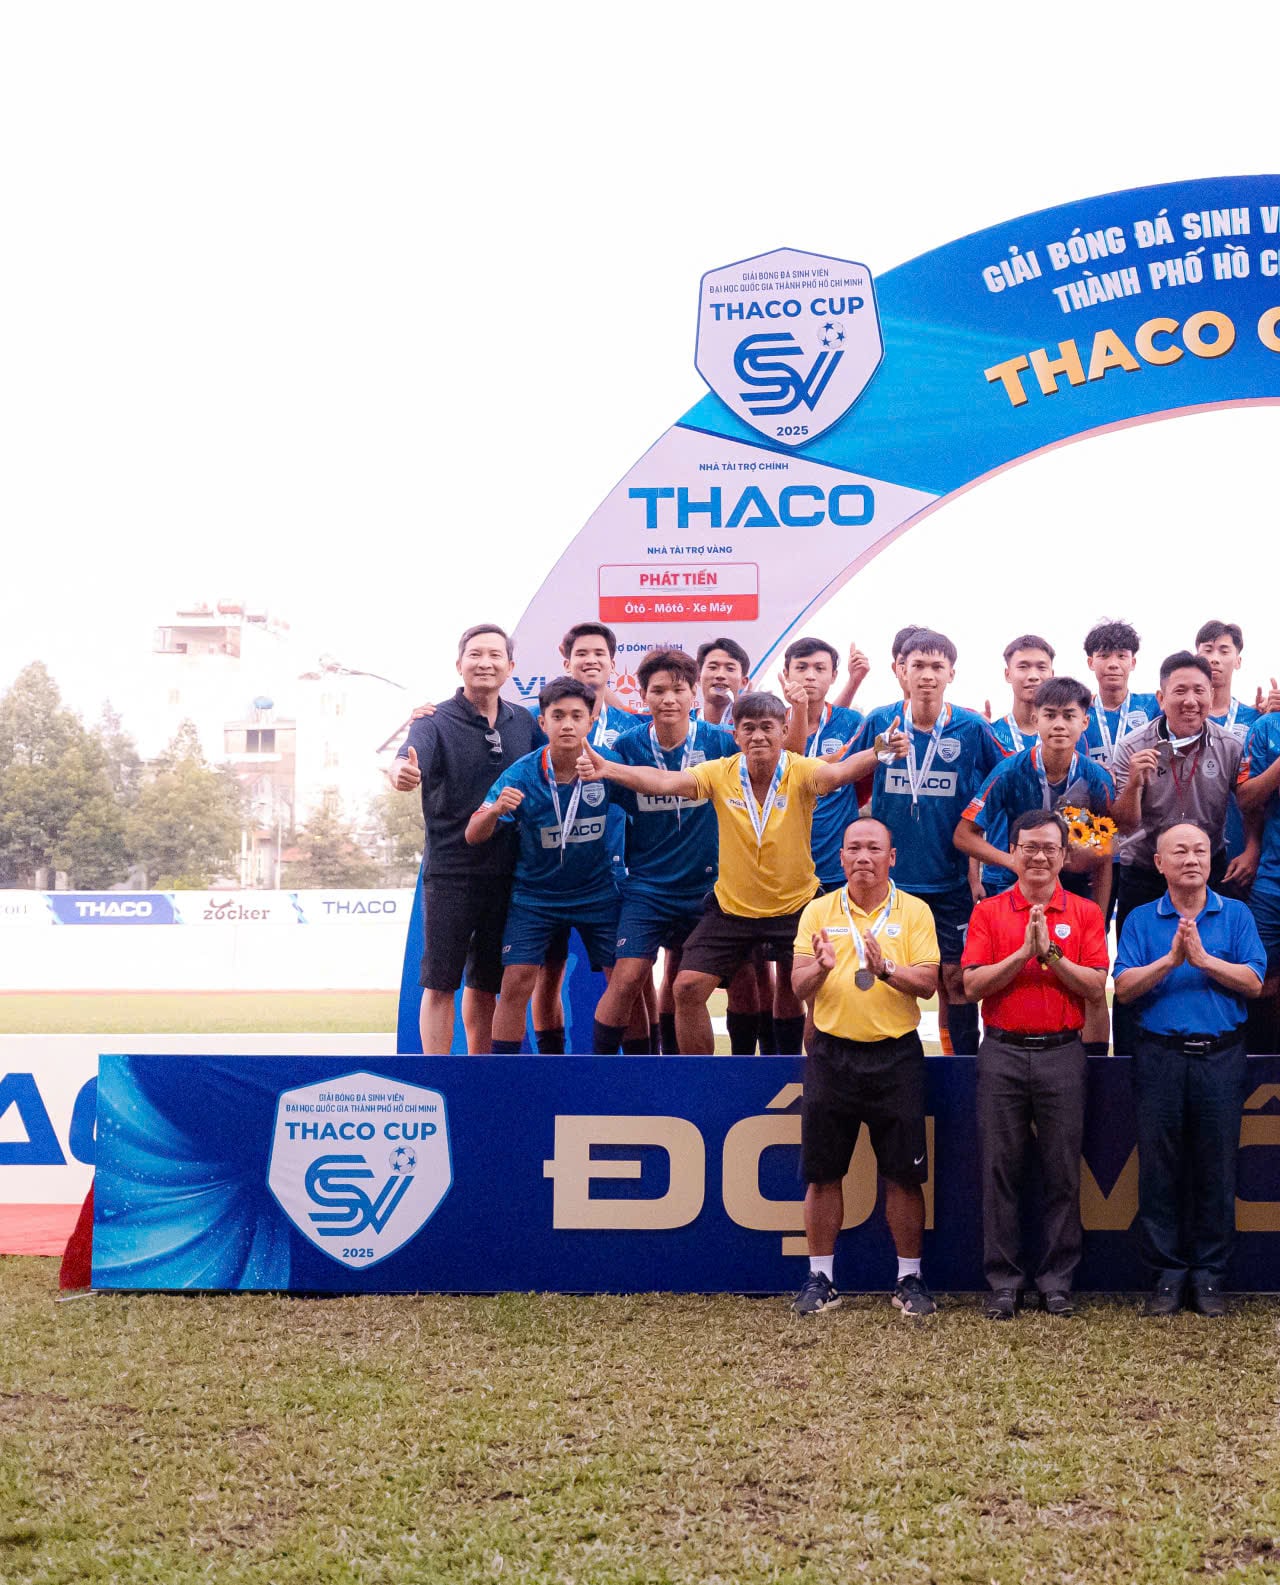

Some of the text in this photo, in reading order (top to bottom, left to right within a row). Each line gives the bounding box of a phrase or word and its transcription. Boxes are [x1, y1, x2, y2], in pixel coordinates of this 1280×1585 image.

[982, 247, 1041, 295] GIẢI
[1051, 225, 1126, 272] BÓNG
[1134, 209, 1175, 250] ĐÁ
[1183, 206, 1250, 241] SINH
[792, 269, 810, 278] SINH
[1052, 267, 1141, 313] THÀNH
[1150, 247, 1206, 289] PHỐ
[1212, 243, 1250, 279] HỒ
[762, 282, 774, 290] GIA
[830, 277, 842, 287] CHÍ
[844, 278, 862, 286] MINH
[710, 296, 864, 321] THACO CUP
[984, 310, 1237, 407] THACO
[776, 426, 808, 436] 2025
[699, 461, 788, 472] NHÀ TÀI TRỢ CHÍNH
[628, 485, 874, 529] THACO
[647, 545, 732, 556] NHÀ TÀI TRỢ VÀNG
[640, 568, 718, 586] PHÁT TIẾN
[624, 602, 646, 614] Ôtô
[654, 602, 684, 614] Môtô
[693, 603, 706, 612] Xe
[710, 602, 733, 614] Máy
[548, 823, 602, 842] TACO
[75, 901, 152, 917] THACO
[322, 900, 396, 914] THACO
[368, 1094, 386, 1102] SINH
[336, 1104, 348, 1112] GIA
[404, 1104, 416, 1112] CHÍ
[418, 1104, 437, 1112] MINH
[285, 1122, 437, 1140] THACO CUP
[342, 1248, 374, 1258] 2025
